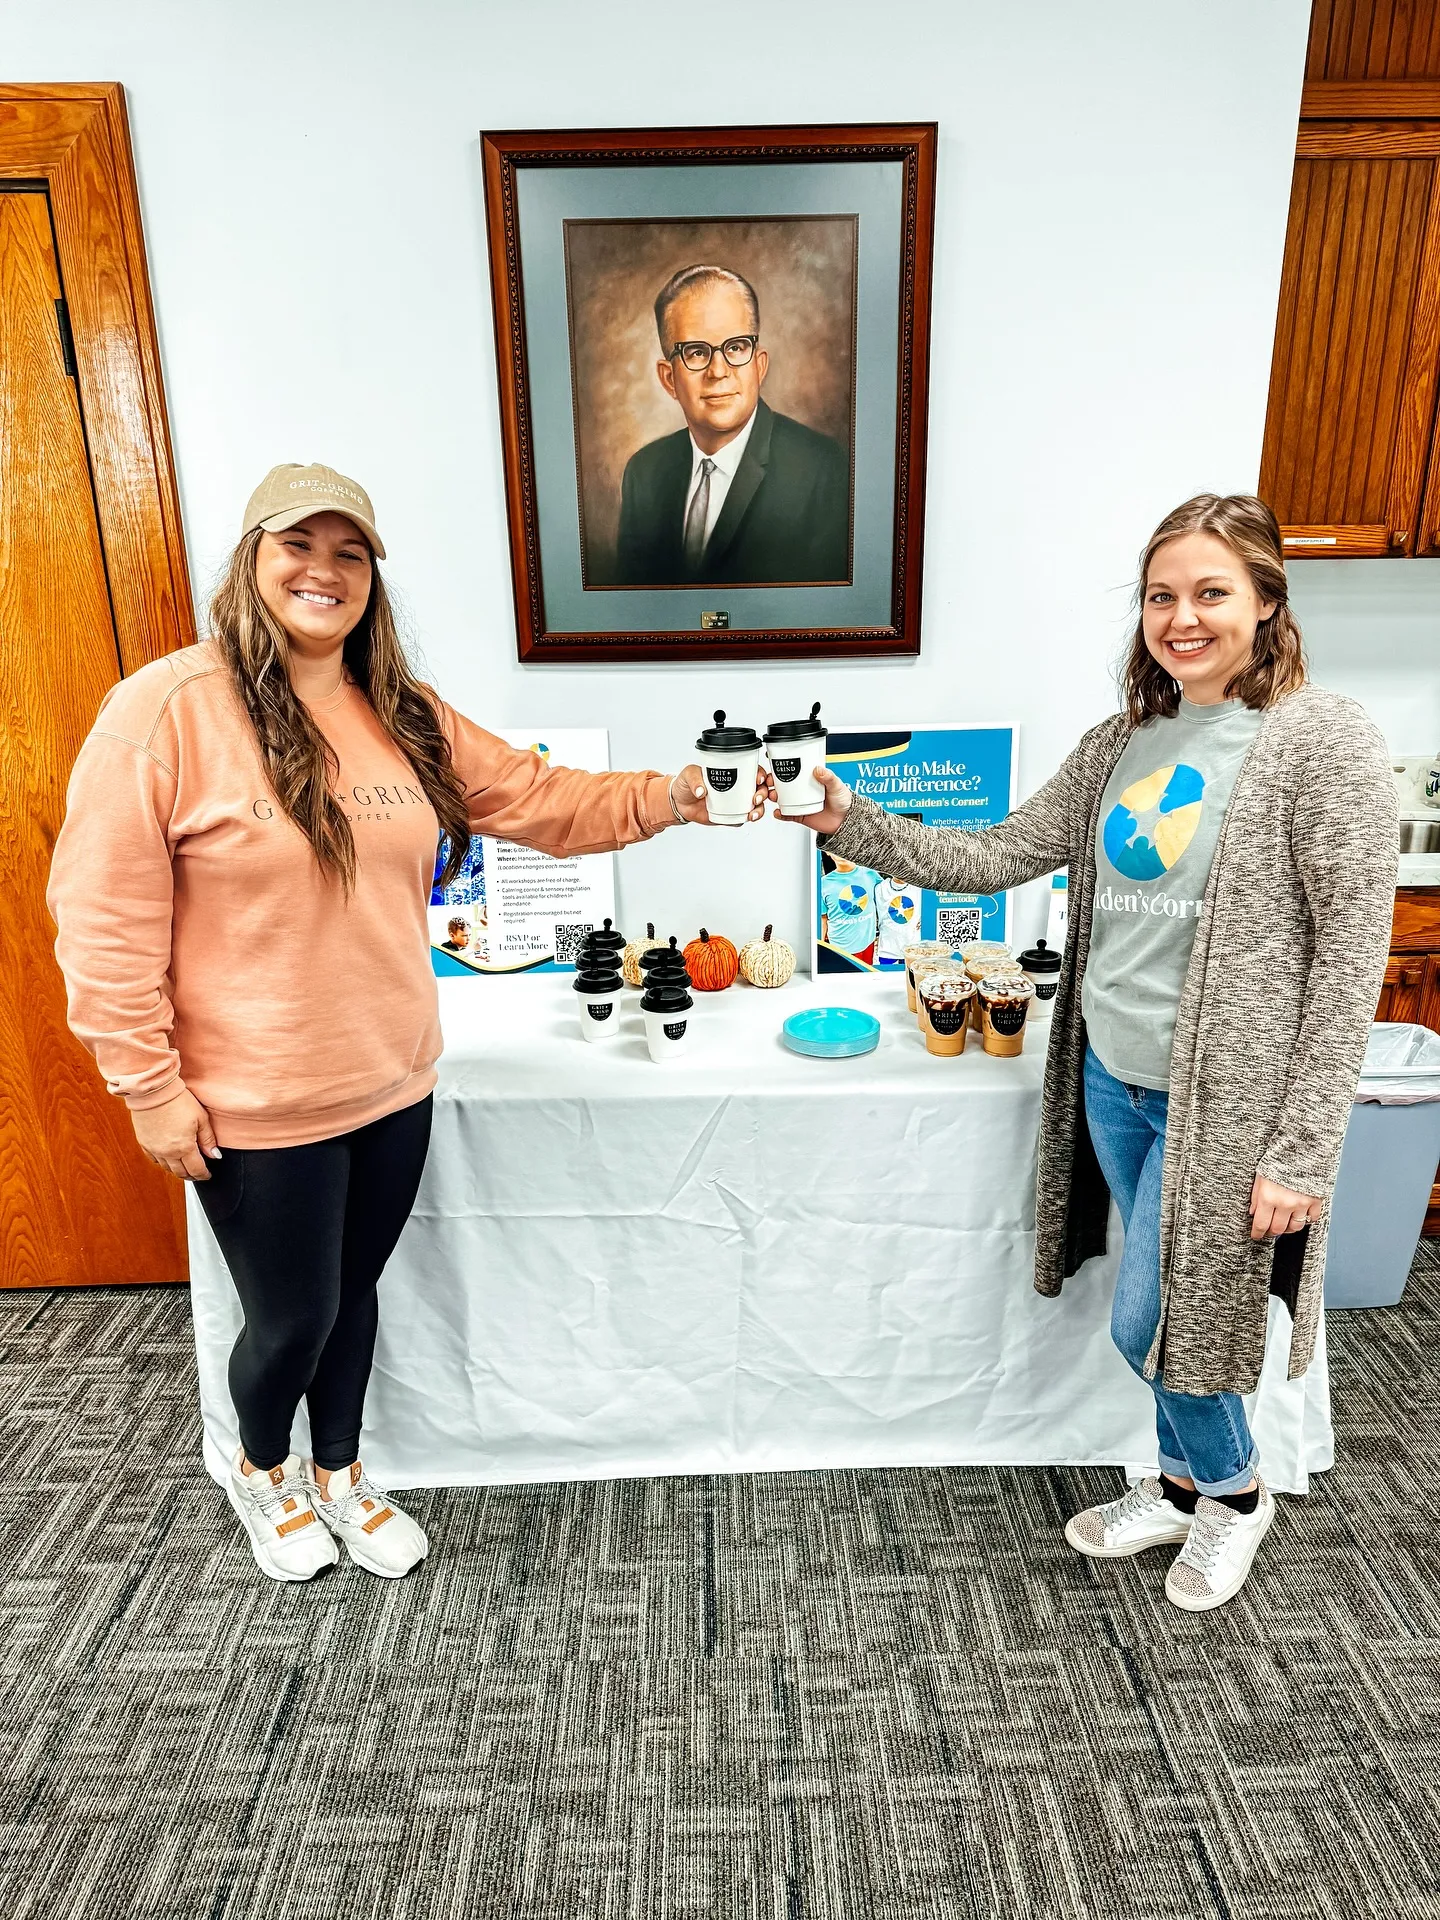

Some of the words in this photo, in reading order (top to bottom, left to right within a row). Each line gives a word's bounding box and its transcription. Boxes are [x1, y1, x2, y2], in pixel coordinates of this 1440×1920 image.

[289, 480, 320, 489] GRIT
[328, 483, 363, 505] GRIND
[857, 762, 901, 778] Want
[903, 763, 919, 777] to
[921, 760, 966, 776] Make
[854, 777, 890, 794] Real
[891, 775, 982, 793] Difference?
[353, 785, 430, 806] GRIN
[886, 800, 908, 809] with
[909, 797, 950, 808] Caiden's
[951, 796, 989, 807] Corner!
[961, 818, 974, 826] you
[958, 895, 979, 905] today
[1093, 885, 1150, 914] iden's
[505, 934, 530, 942] RSVP
[498, 943, 525, 951] Learn
[526, 942, 549, 951] More
